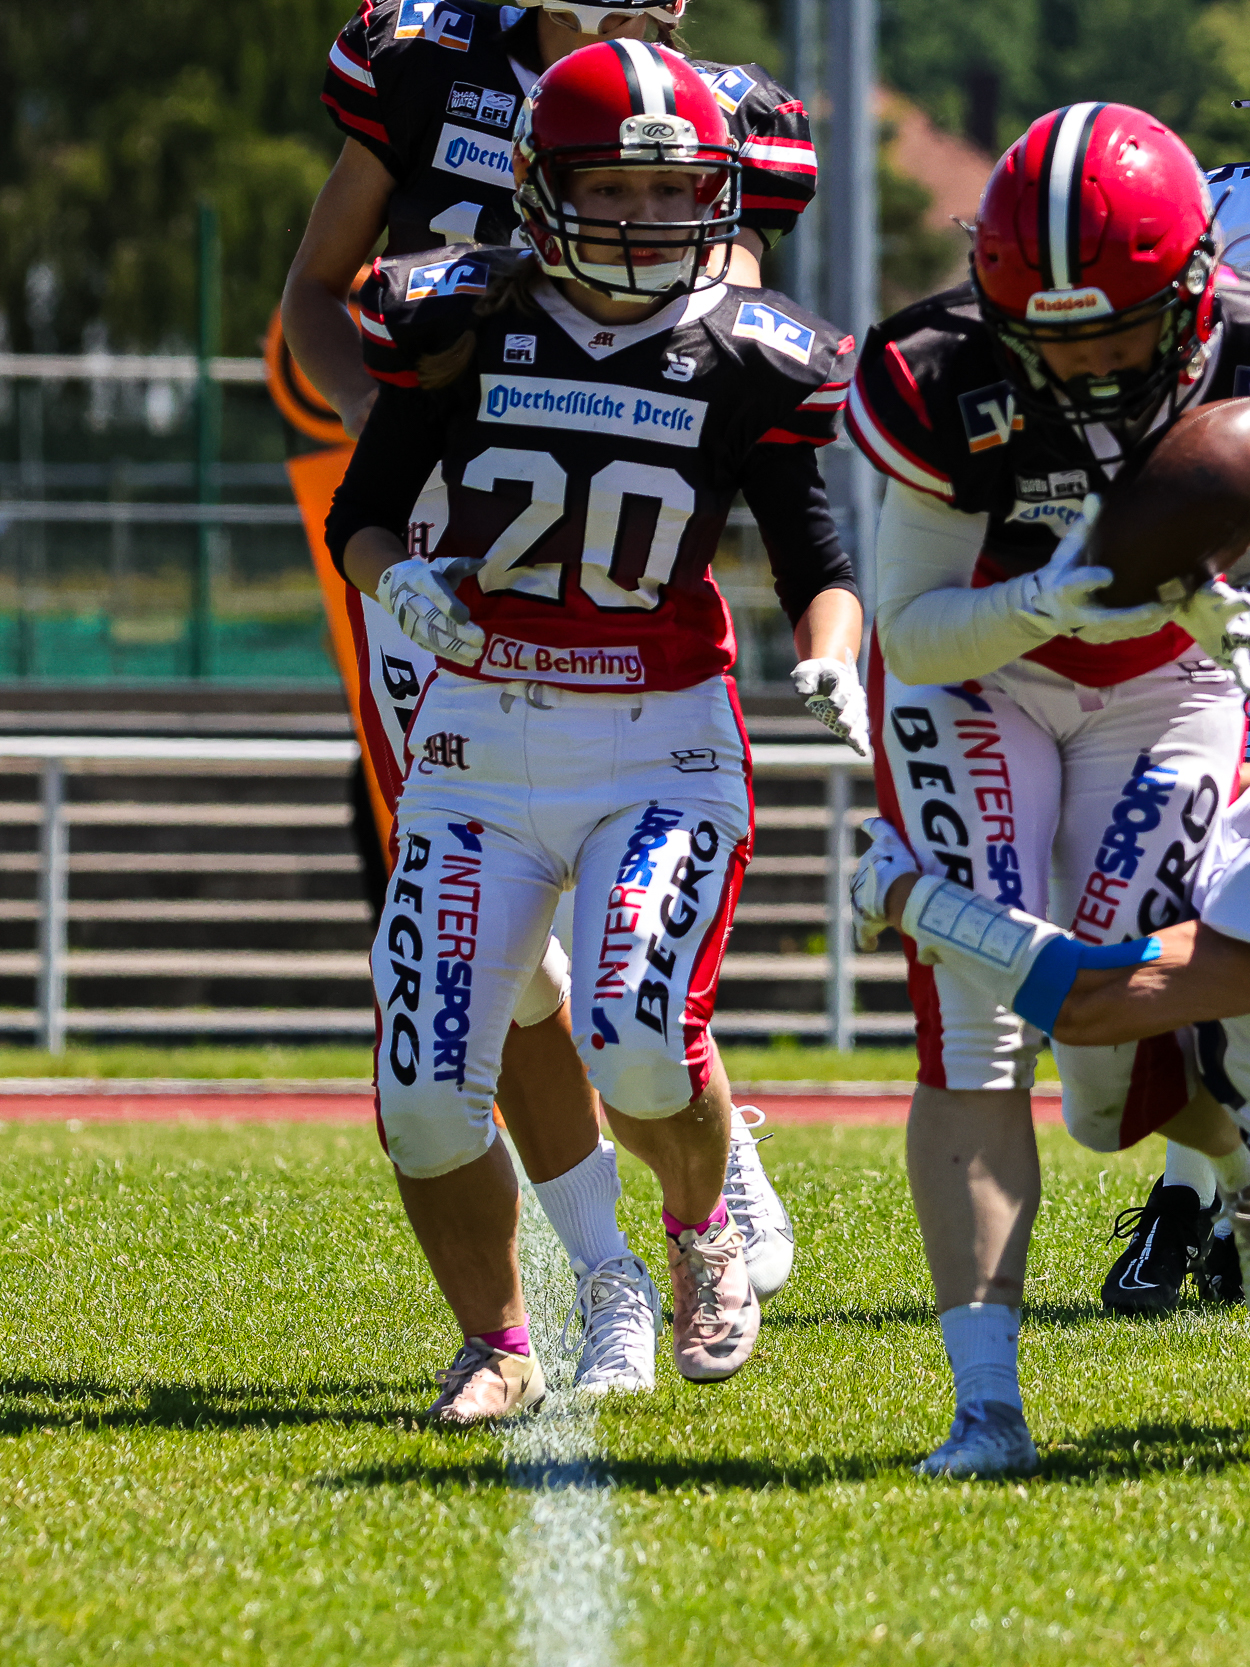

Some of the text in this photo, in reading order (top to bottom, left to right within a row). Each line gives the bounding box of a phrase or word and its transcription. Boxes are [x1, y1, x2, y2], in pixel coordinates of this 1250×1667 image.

[480, 105, 509, 121] GFL
[505, 348, 534, 362] GFL
[1034, 293, 1098, 312] Riddell
[460, 446, 696, 613] 20
[485, 636, 644, 681] CSL Behring
[387, 828, 432, 1087] BEGRO
[433, 855, 482, 1085] INTERSPORT
[593, 803, 685, 999] INTERSPORT
[634, 820, 720, 1046] BEGRO
